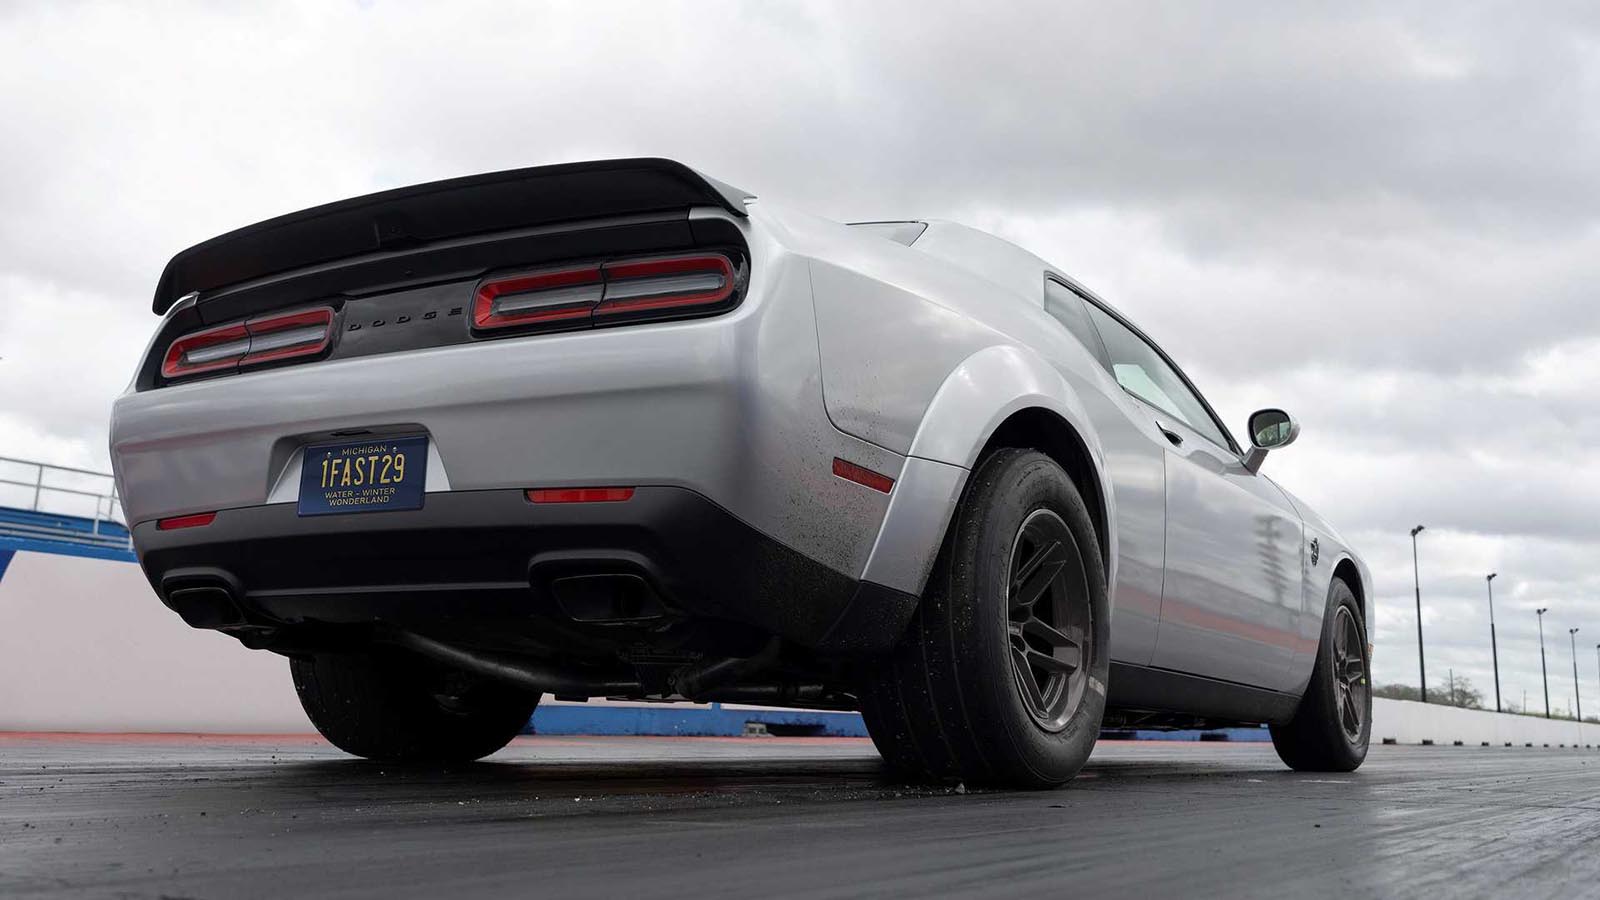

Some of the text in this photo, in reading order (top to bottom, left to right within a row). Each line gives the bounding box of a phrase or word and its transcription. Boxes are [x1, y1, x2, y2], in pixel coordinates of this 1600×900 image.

[348, 307, 463, 331] DODGE
[342, 446, 386, 455] MICHIGAN
[321, 453, 405, 488] 1FAST29
[325, 490, 353, 499] WATER
[362, 487, 396, 496] WINTER
[329, 496, 389, 506] WONDERLAND
